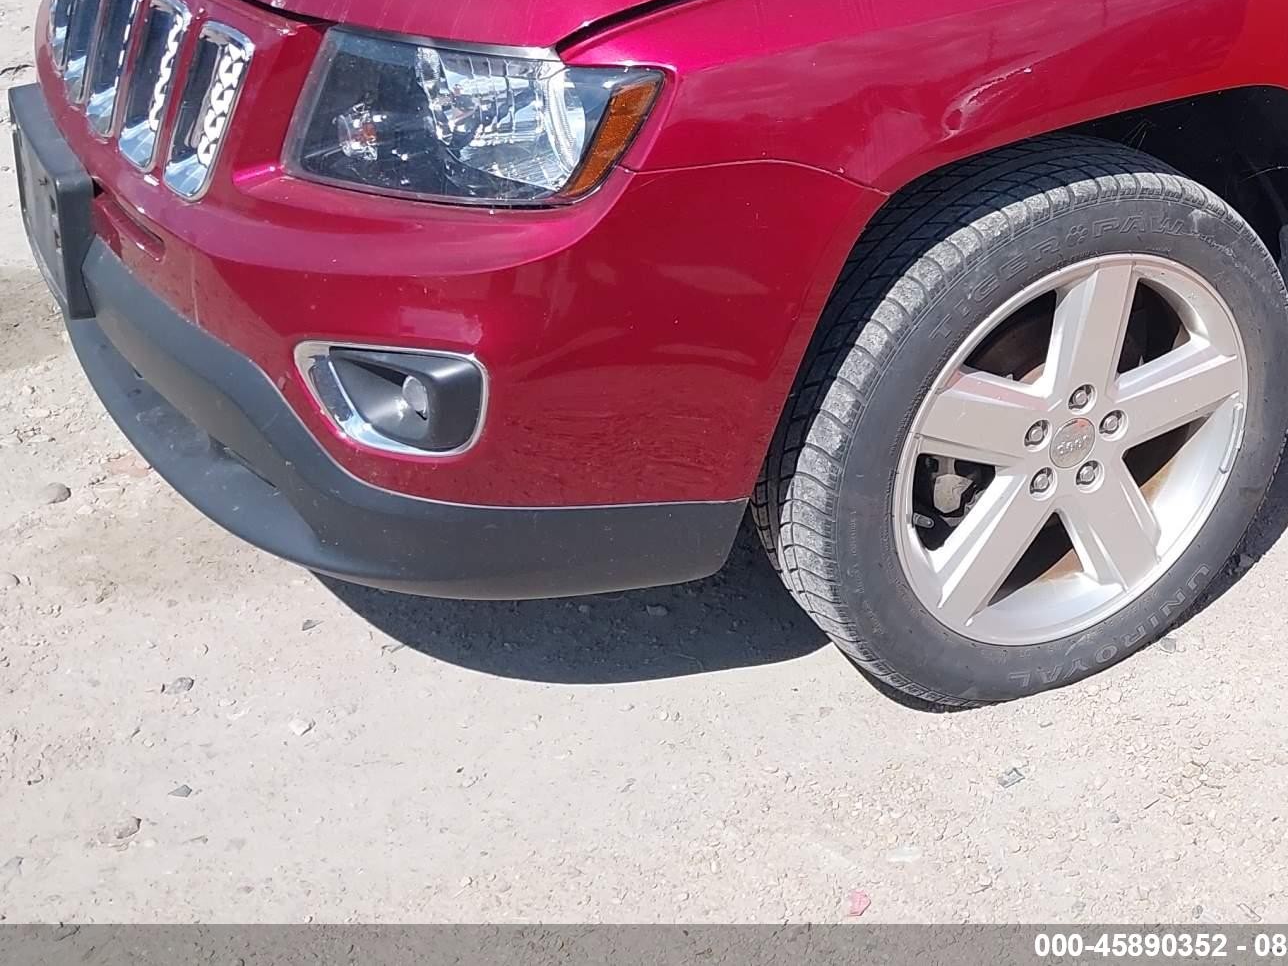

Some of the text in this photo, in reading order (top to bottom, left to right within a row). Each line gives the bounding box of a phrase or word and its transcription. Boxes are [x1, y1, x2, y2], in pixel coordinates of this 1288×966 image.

[928, 215, 1186, 339] TIGER PAW
[1007, 563, 1211, 688] UNIROYAL
